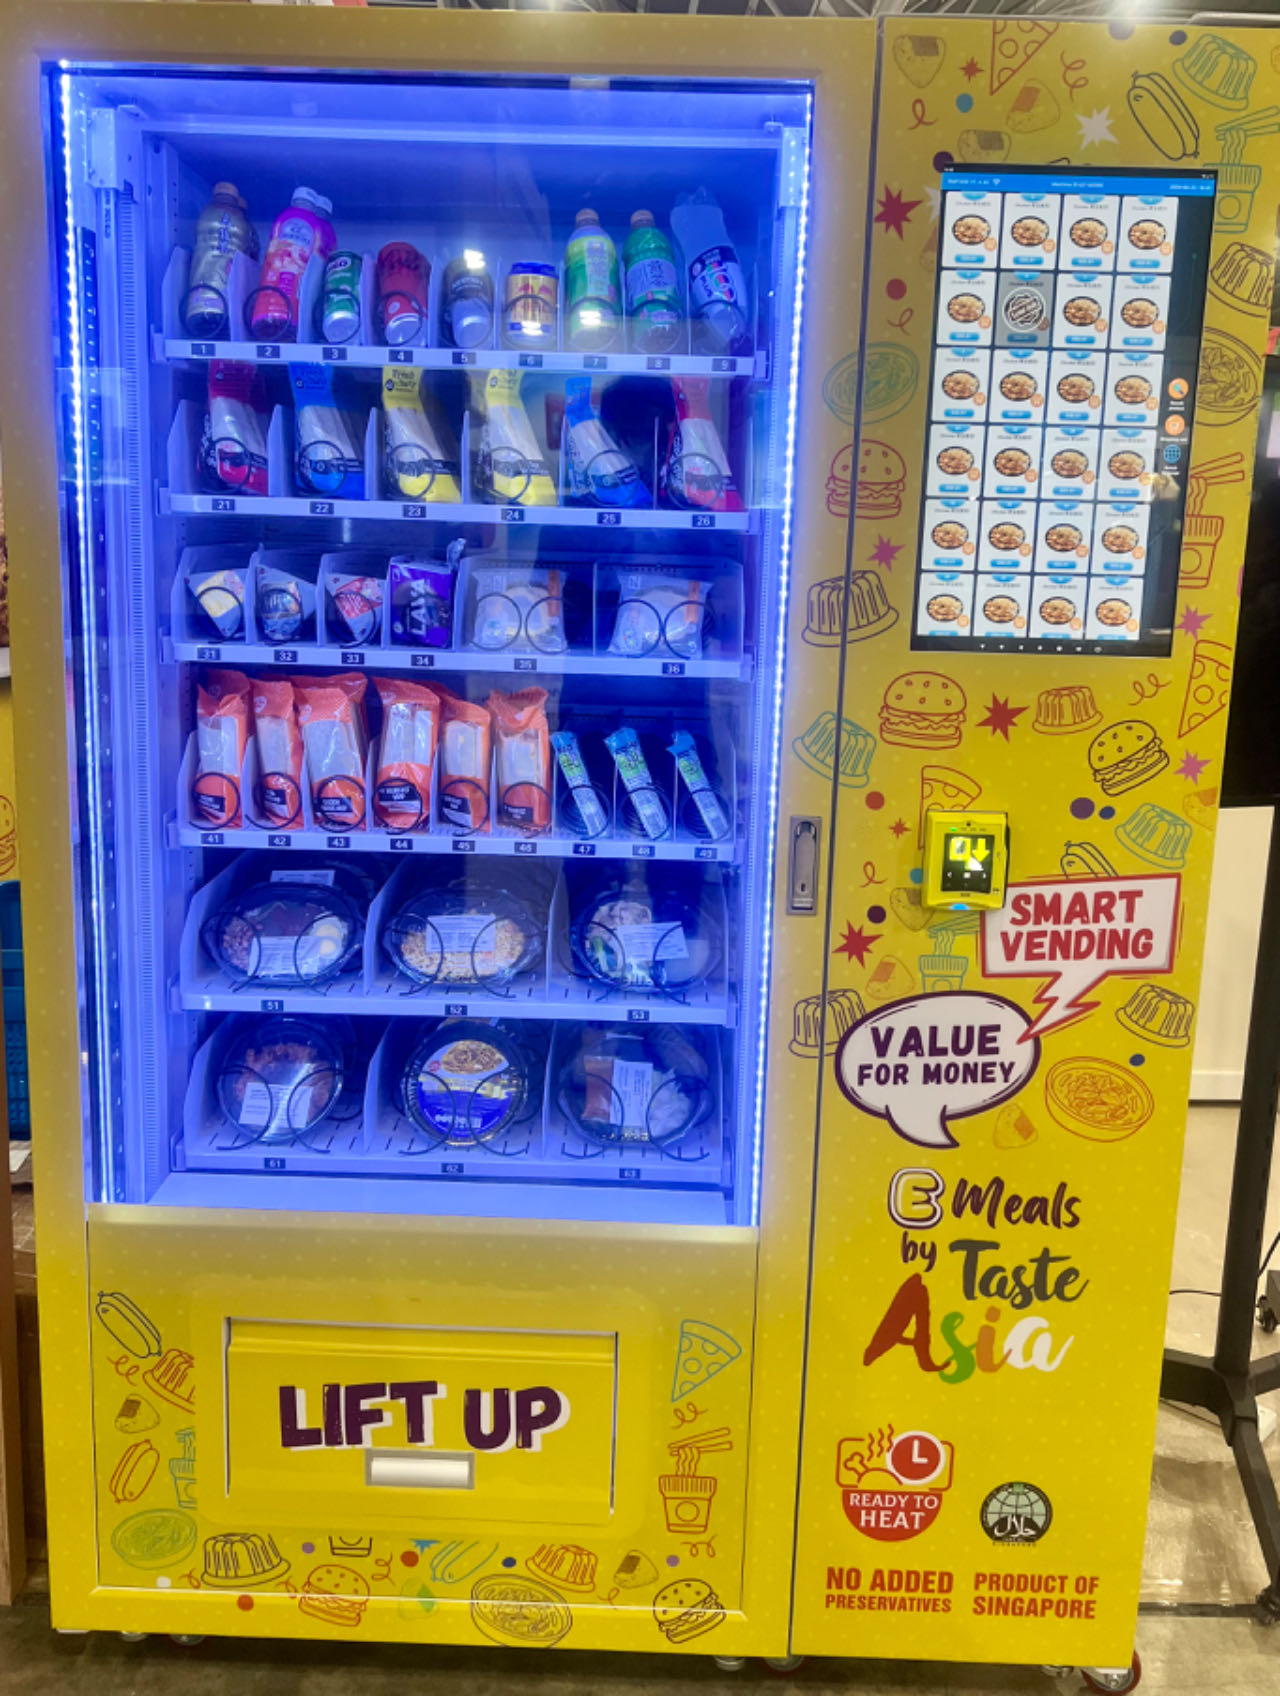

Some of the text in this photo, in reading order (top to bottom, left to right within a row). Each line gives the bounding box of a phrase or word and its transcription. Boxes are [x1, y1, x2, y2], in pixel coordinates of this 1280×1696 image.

[1010, 890, 1143, 927] SMART
[1000, 928, 1153, 962] VENDING
[871, 1025, 1001, 1058] VALUE
[857, 1061, 1015, 1086] FOR MONEY
[888, 1167, 1081, 1229] E Meals
[901, 1231, 1090, 1310] by Taste
[862, 1273, 1074, 1385] Asia
[279, 1381, 571, 1452] LIFT UP
[849, 1493, 939, 1510] READY TO
[860, 1510, 925, 1530] HEAT
[826, 1567, 954, 1595] NO ADDED
[973, 1572, 1100, 1595] PRODUCT OF
[825, 1594, 952, 1613] PRESERVATIVES
[972, 1597, 1097, 1620] SINGAPORE
